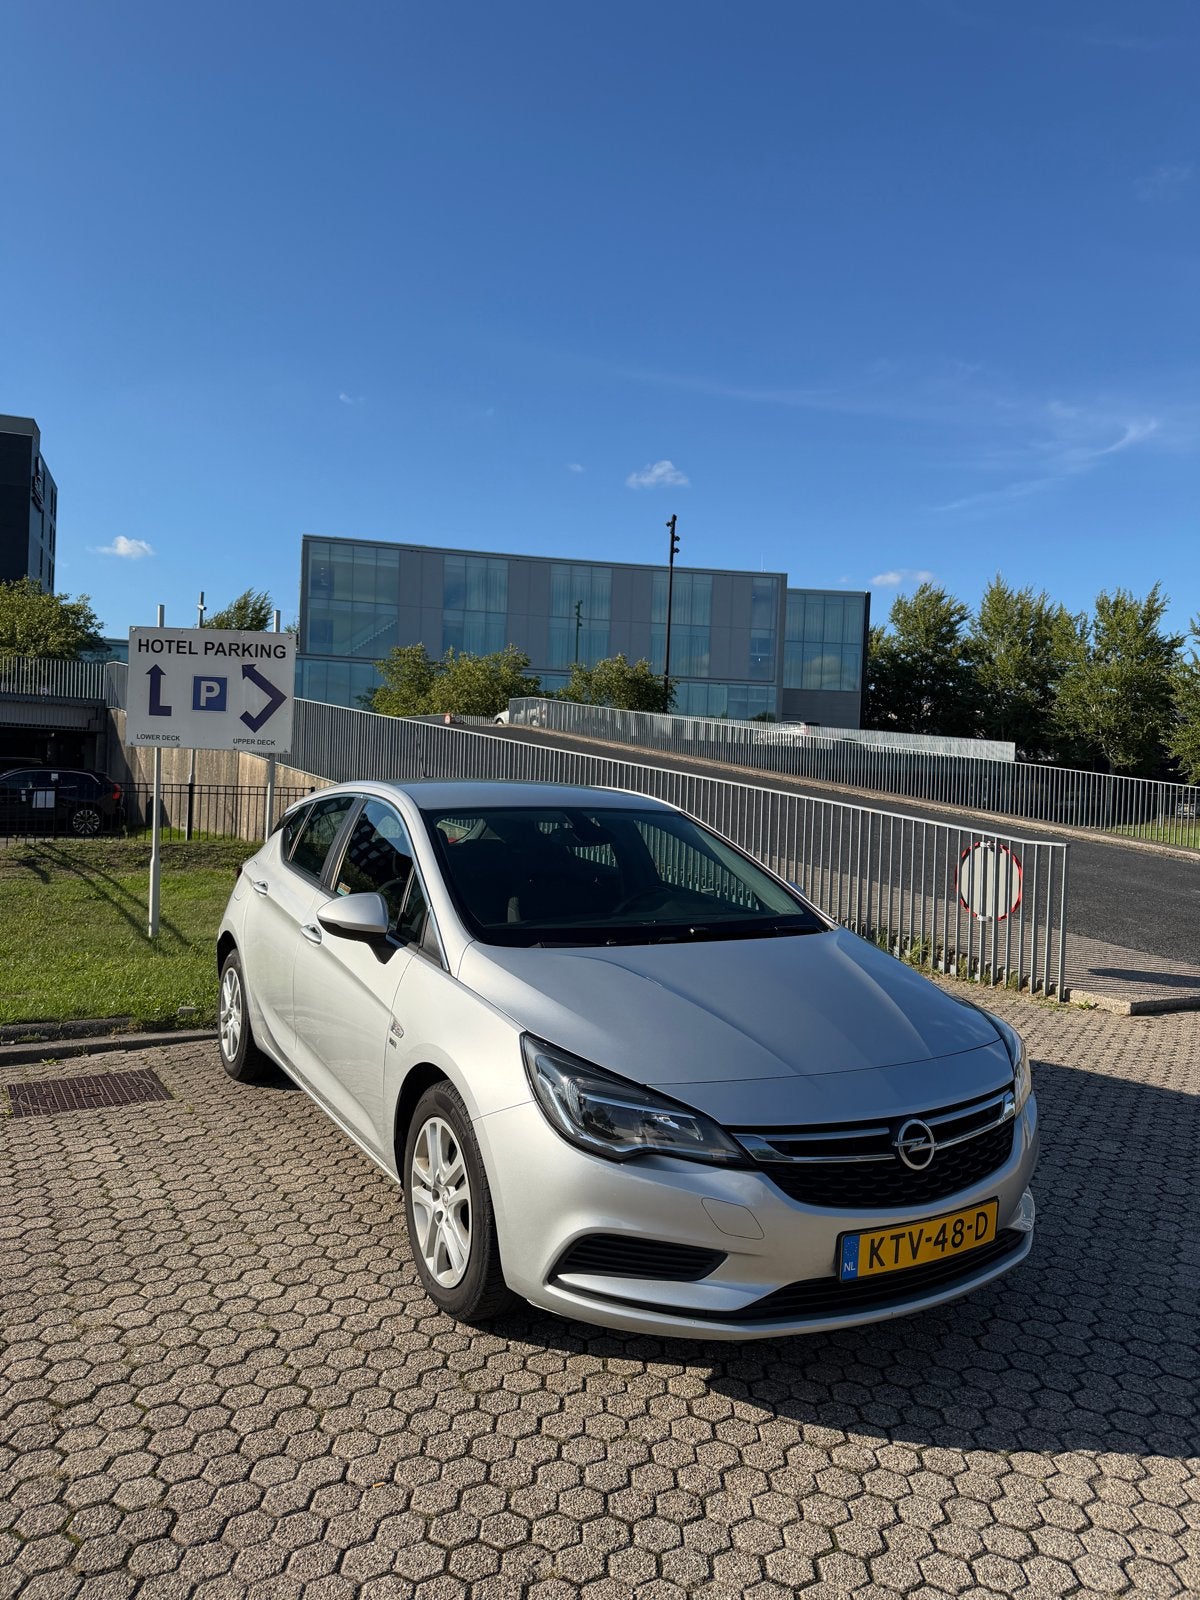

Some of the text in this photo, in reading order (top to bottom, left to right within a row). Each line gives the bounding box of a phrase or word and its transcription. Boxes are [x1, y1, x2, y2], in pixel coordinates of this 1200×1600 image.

[138, 638, 287, 659] HOTEL PARKING
[199, 680, 221, 707] P
[136, 733, 181, 742] LOWER DECK
[232, 738, 256, 746] UPPER
[868, 1211, 989, 1269] KTV-48-D
[843, 1262, 856, 1272] NL
